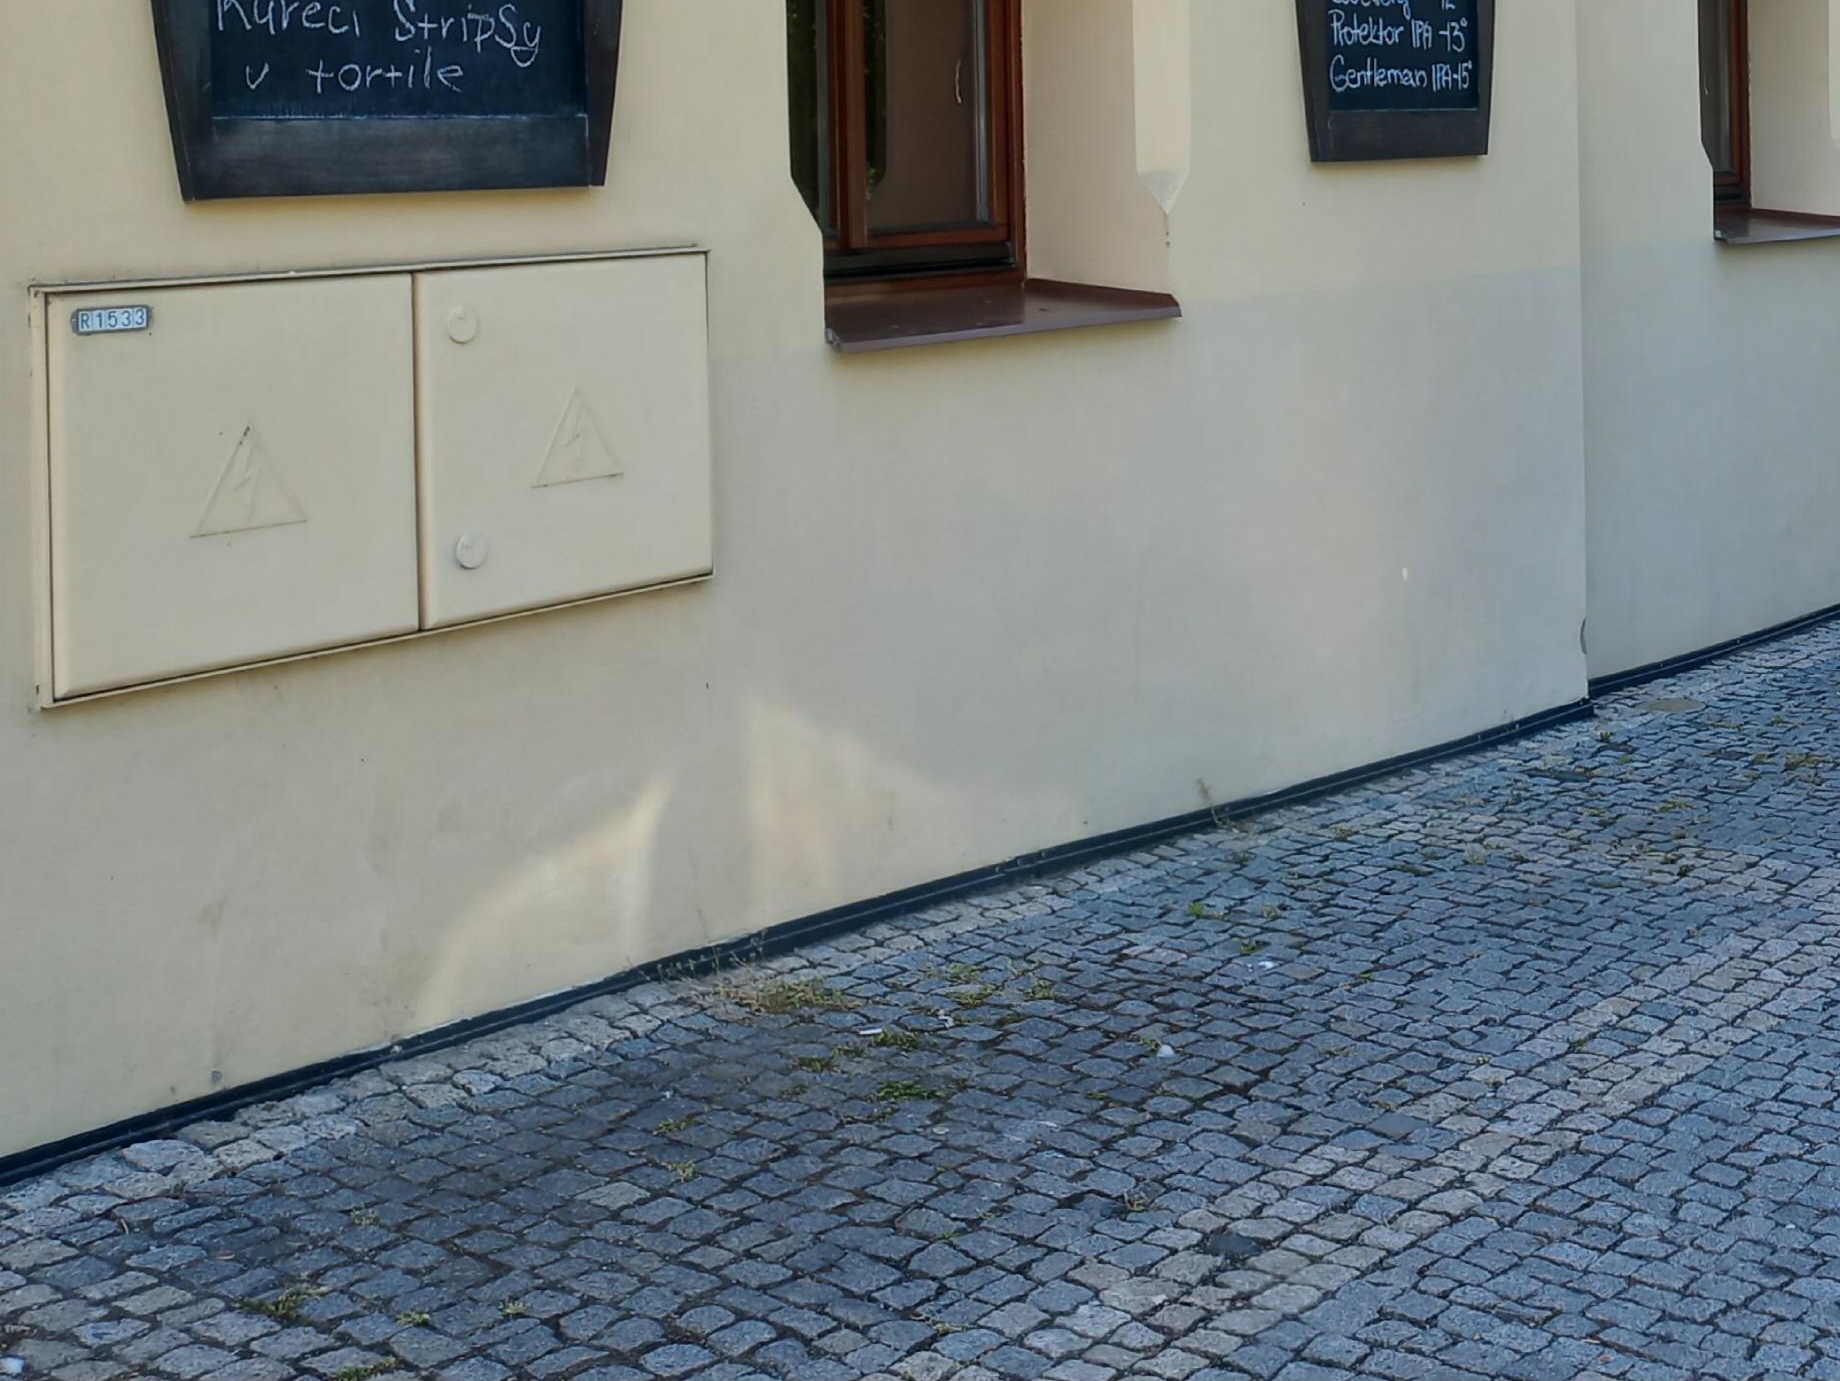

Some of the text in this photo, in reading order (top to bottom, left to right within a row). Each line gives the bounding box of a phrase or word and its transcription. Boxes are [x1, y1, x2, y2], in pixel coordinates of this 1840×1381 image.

[1328, 9, 1404, 46] Protektor
[1411, 19, 1433, 50] IPA
[308, 46, 464, 94] tortile
[1330, 54, 1428, 92] Gentleman
